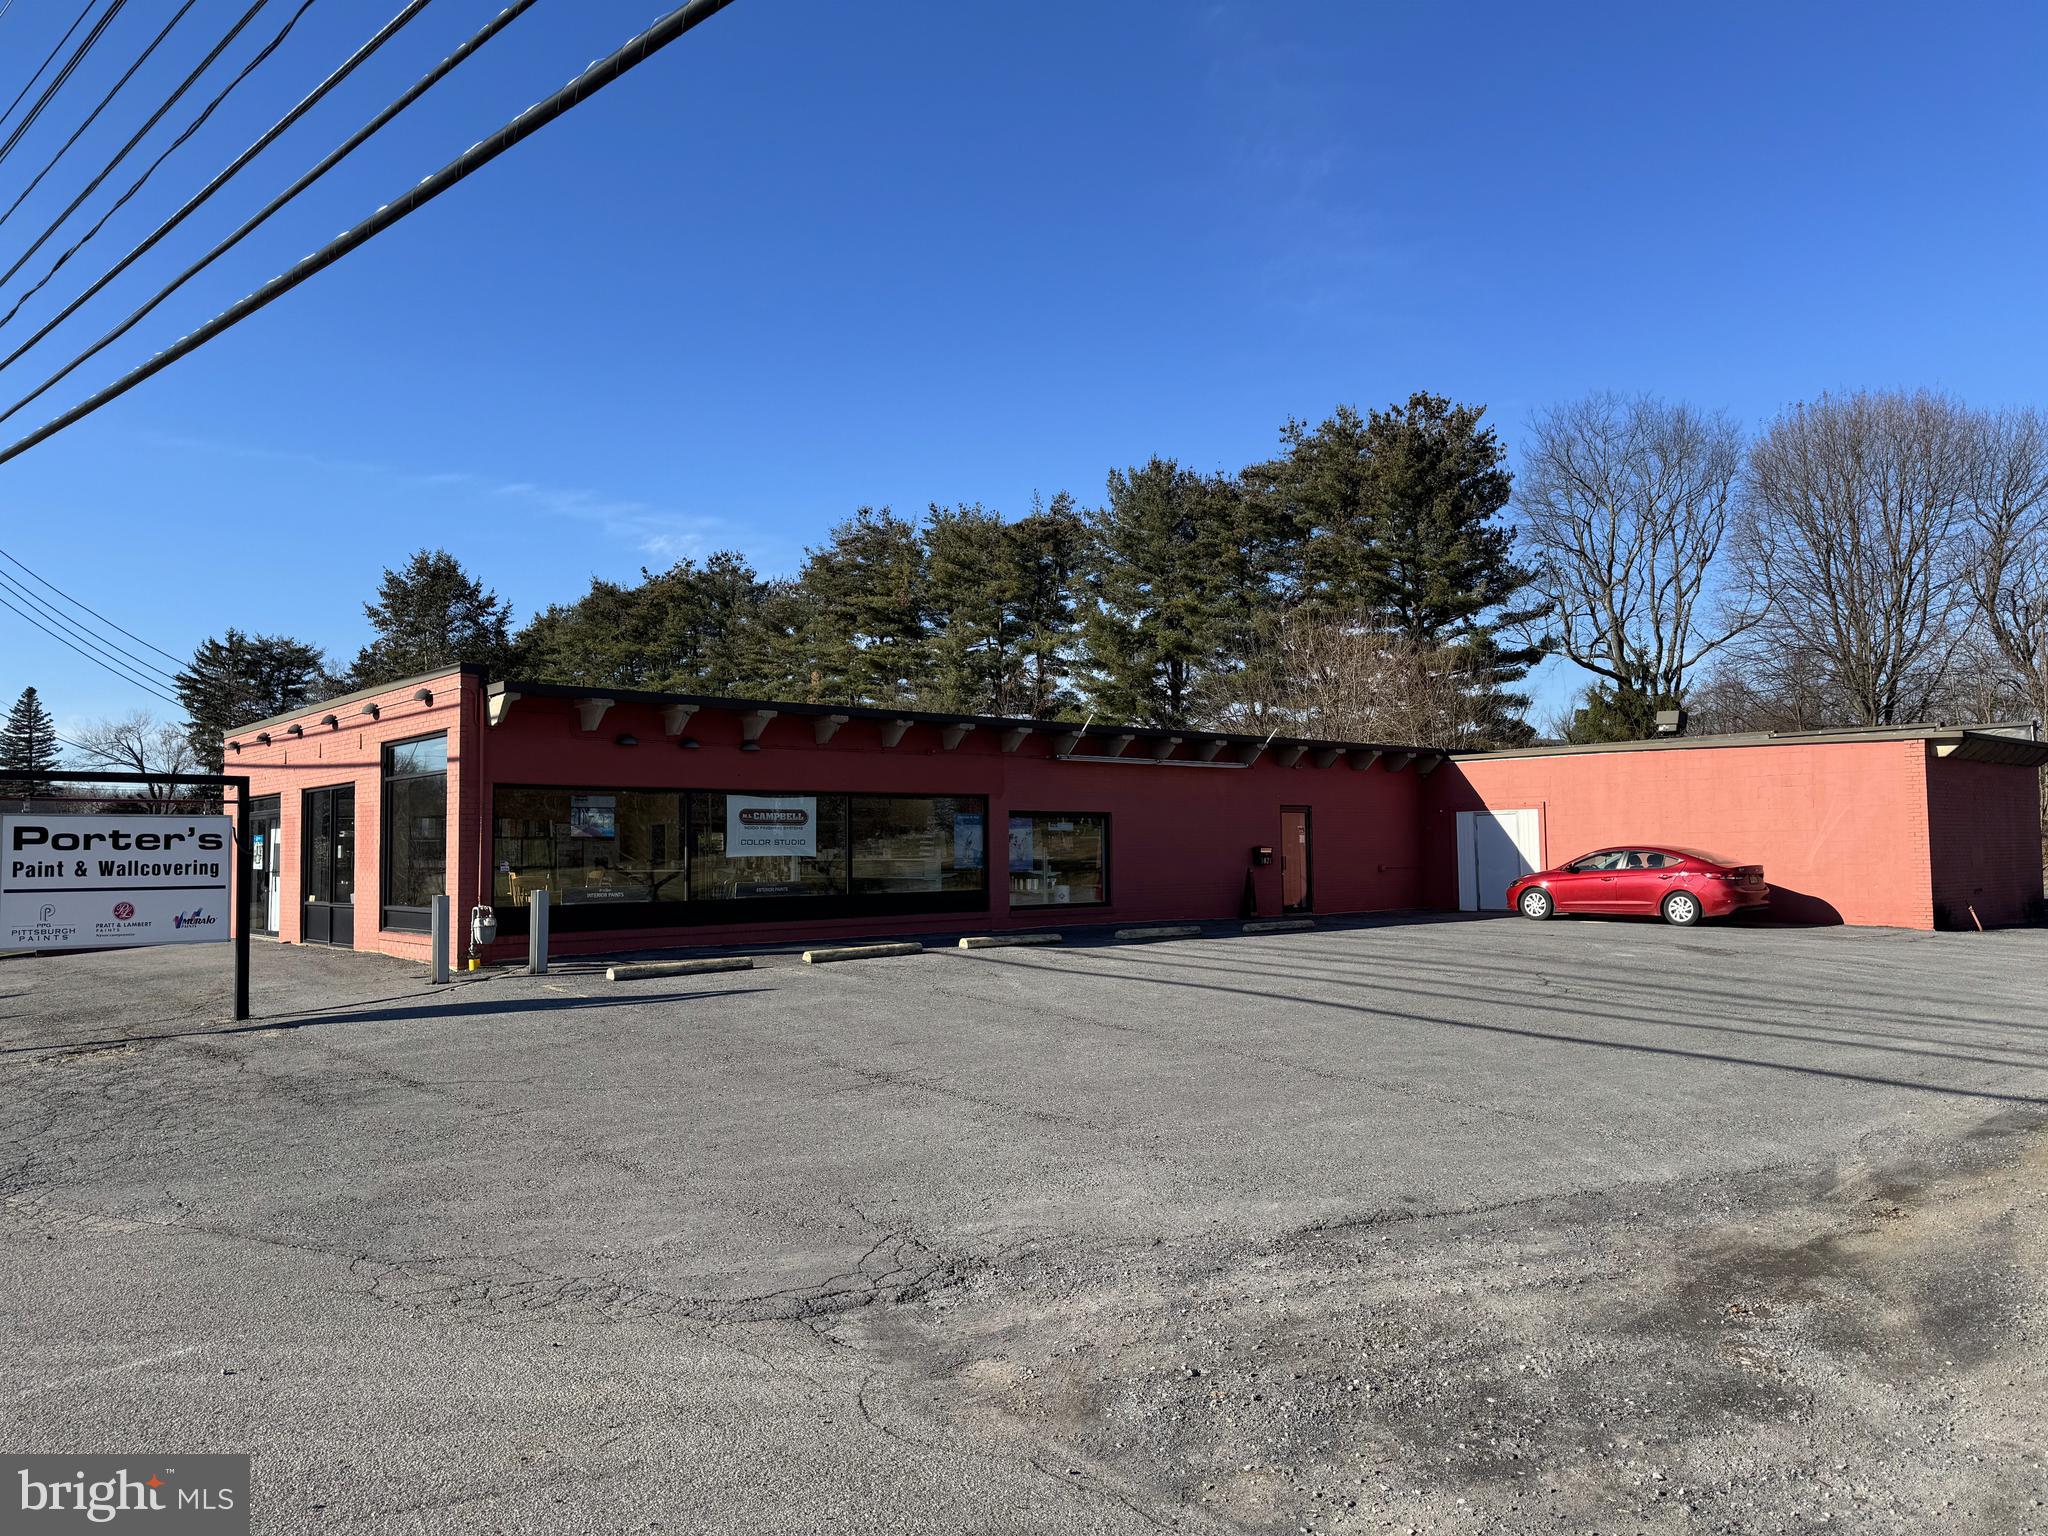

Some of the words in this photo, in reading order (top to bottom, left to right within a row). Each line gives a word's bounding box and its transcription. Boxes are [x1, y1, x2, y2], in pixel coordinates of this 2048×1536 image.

[753, 812, 804, 821] CAMPBELL
[13, 826, 223, 851] Porter's
[12, 861, 64, 878] Paint
[74, 861, 88, 877] &
[98, 860, 219, 878] Wallcovering
[11, 928, 76, 937] PITTSBURGH
